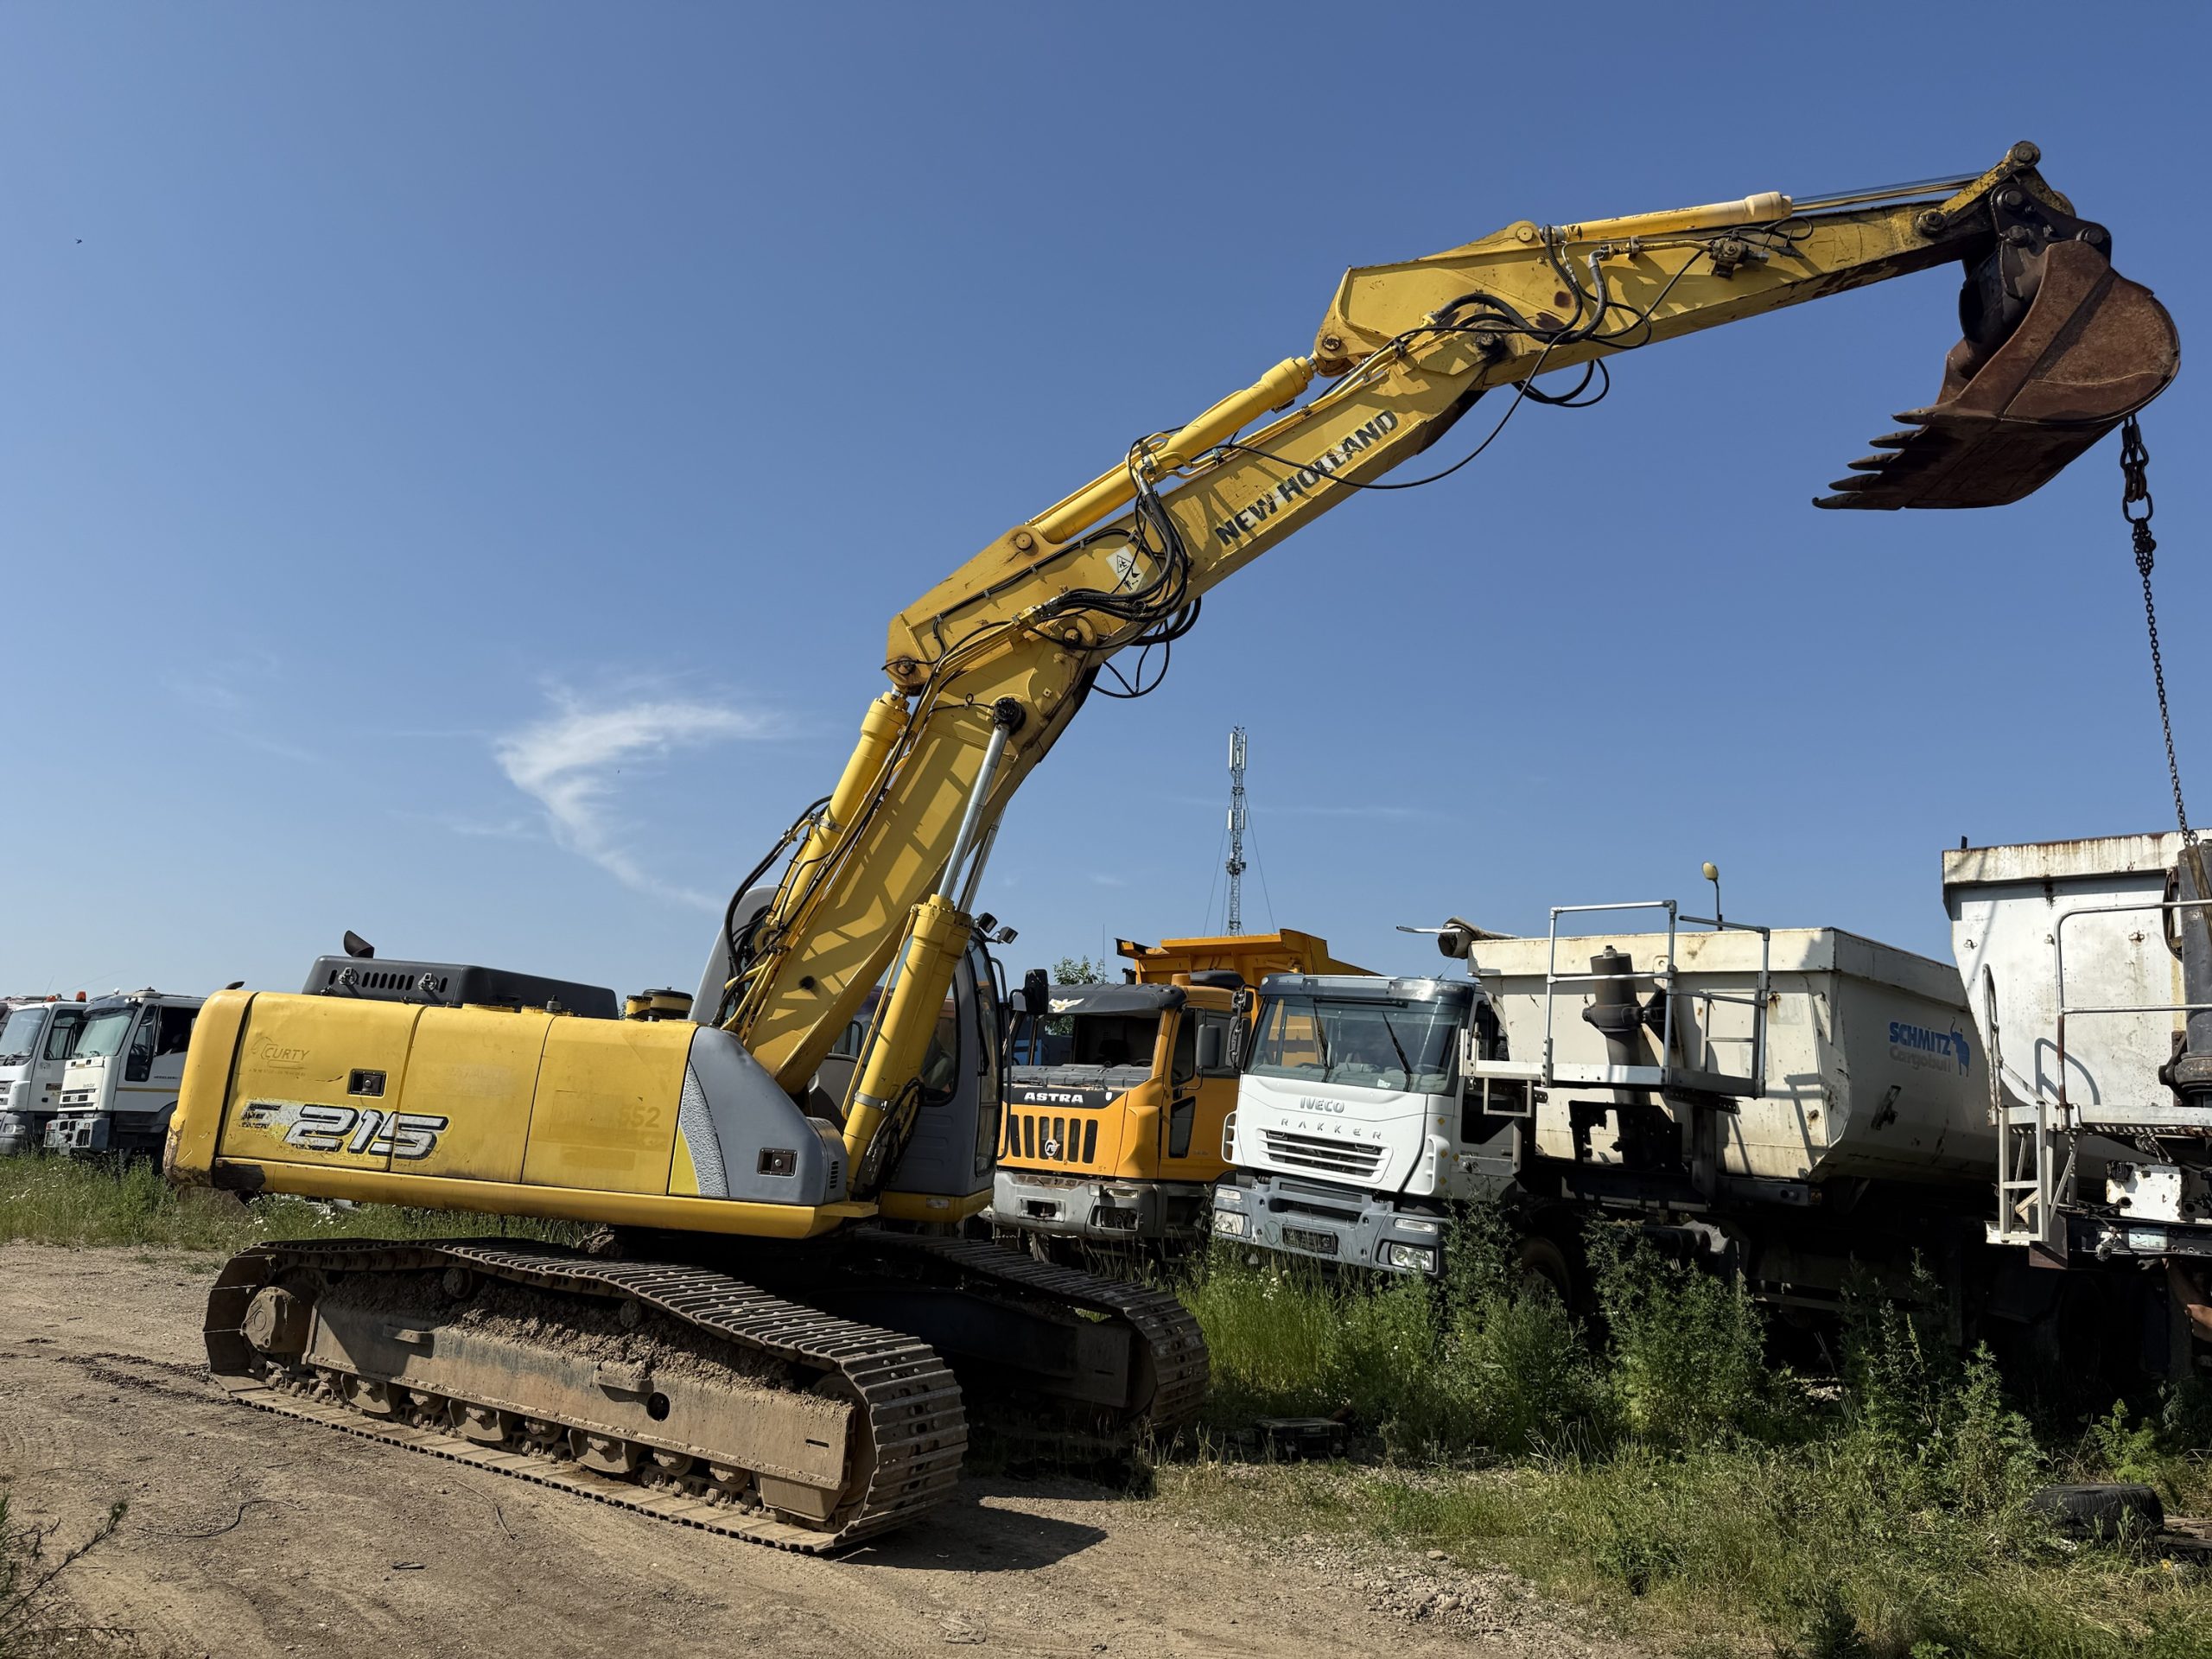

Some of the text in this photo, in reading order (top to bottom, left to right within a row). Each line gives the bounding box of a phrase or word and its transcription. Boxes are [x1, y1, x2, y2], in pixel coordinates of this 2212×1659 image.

[1215, 493, 1278, 546] NEW
[1276, 410, 1399, 504] HOLLAND
[1889, 1021, 1951, 1056] SCHMITZ
[264, 1047, 310, 1061] CURTY
[1889, 1045, 1951, 1072] Cargobull
[1024, 1091, 1084, 1103] ASTRA
[1300, 1096, 1345, 1113] IVECO
[283, 1103, 449, 1160] 215
[1281, 1118, 1382, 1140] RAKKER
